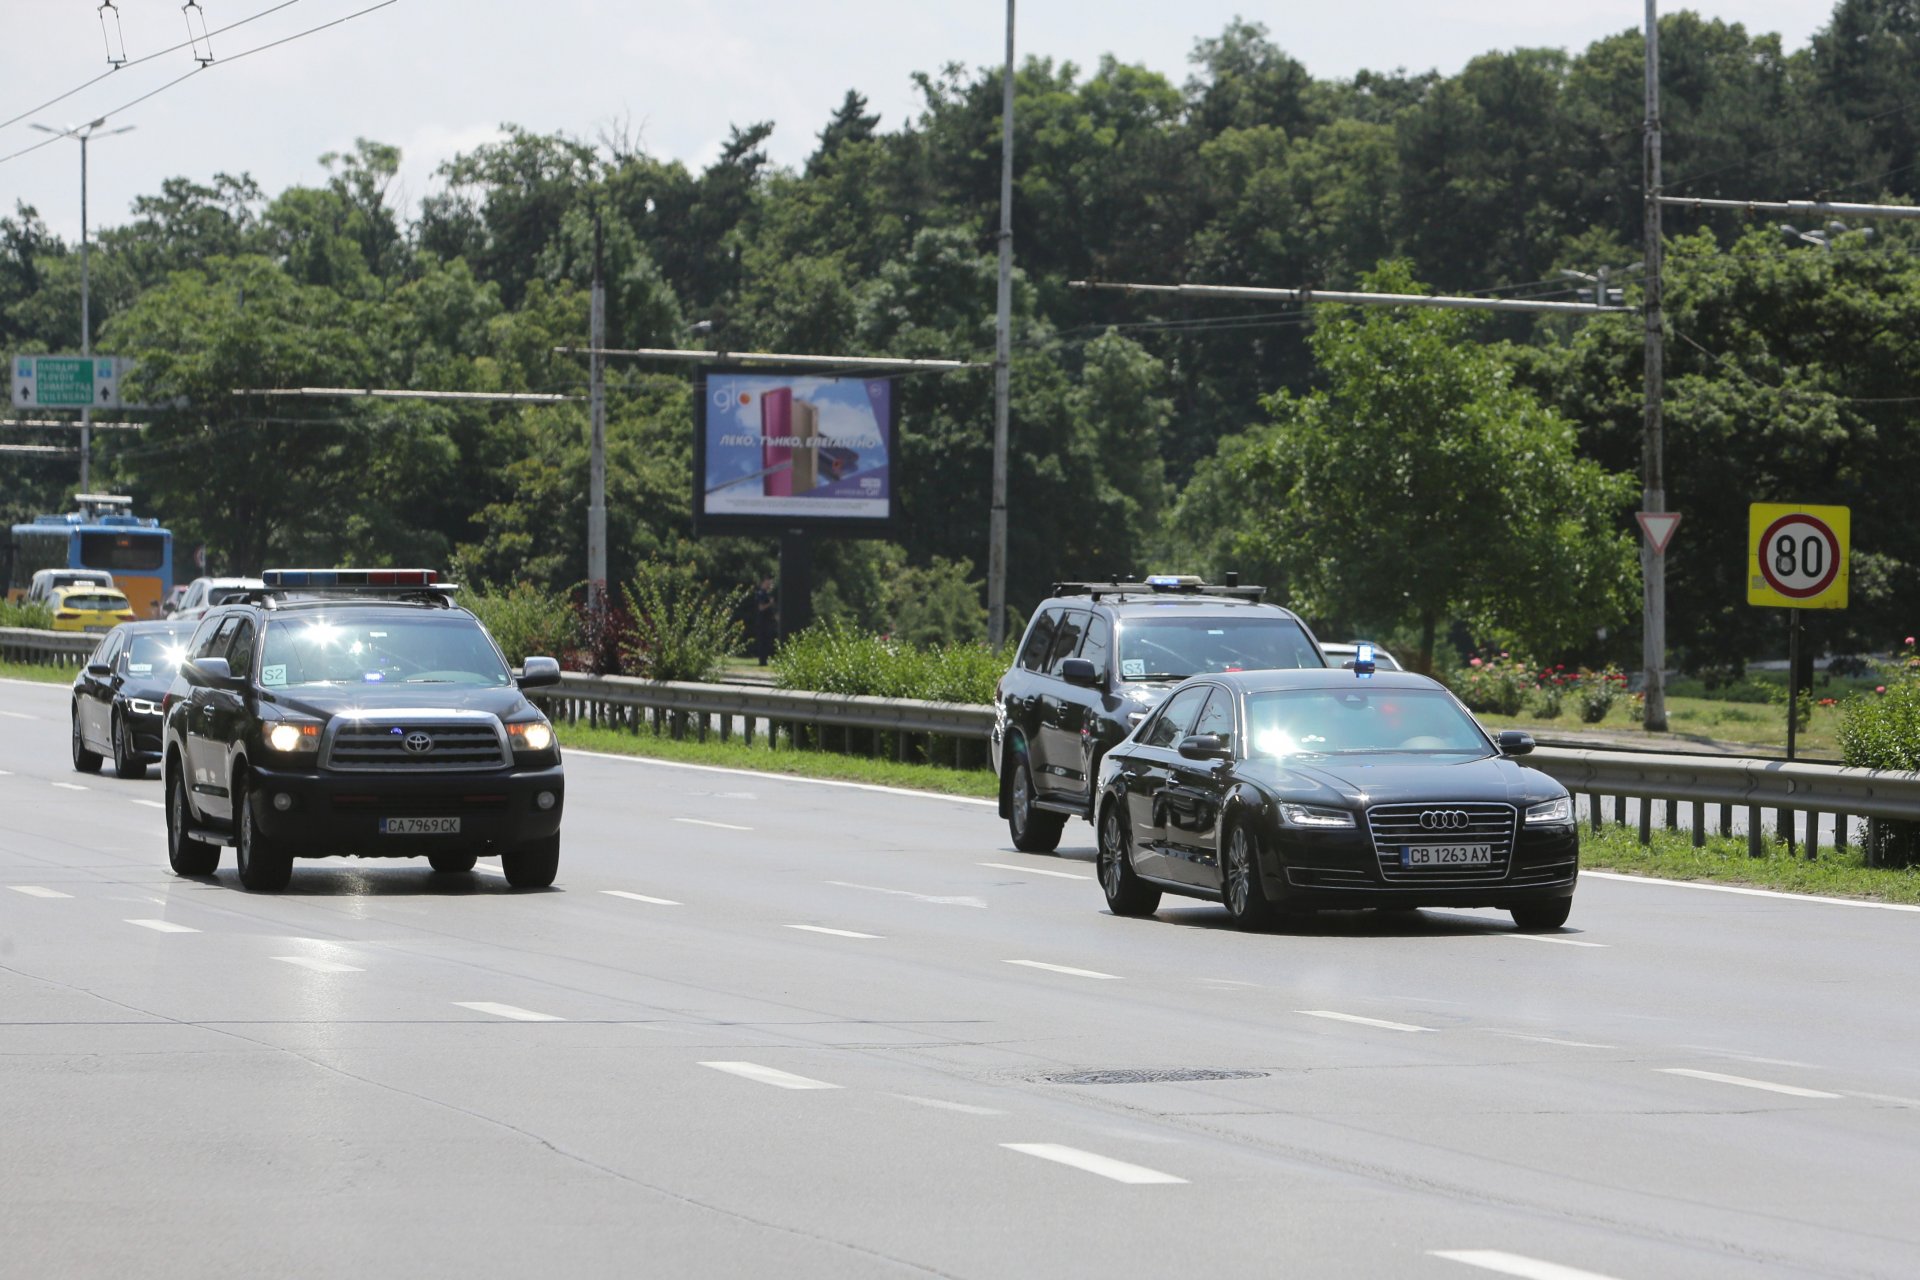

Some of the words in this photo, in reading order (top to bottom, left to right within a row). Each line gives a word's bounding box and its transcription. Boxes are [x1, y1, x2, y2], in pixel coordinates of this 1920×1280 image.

[713, 381, 752, 413] glo
[1776, 534, 1823, 578] 80
[264, 669, 284, 681] S2
[1124, 663, 1143, 675] S3
[1411, 848, 1430, 863] CB
[1435, 847, 1467, 863] 1263
[1471, 847, 1489, 862] AX
